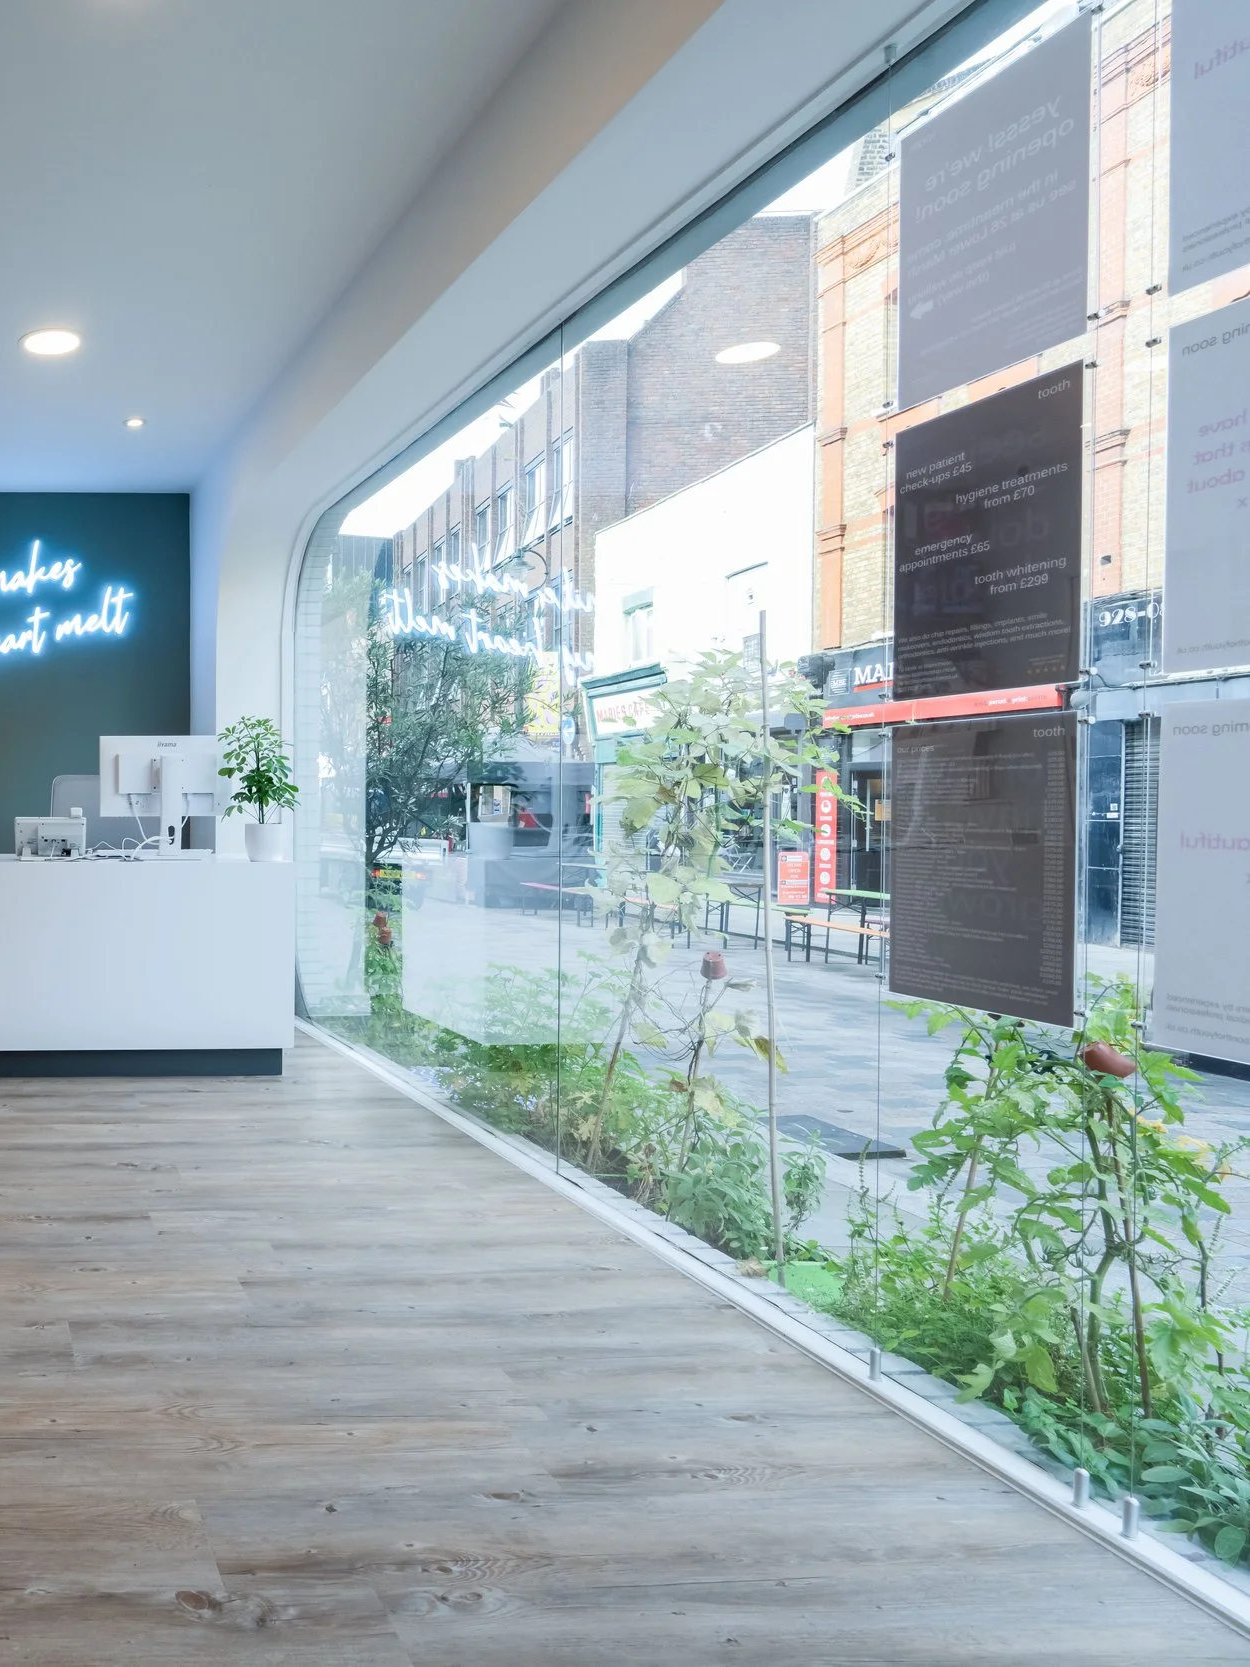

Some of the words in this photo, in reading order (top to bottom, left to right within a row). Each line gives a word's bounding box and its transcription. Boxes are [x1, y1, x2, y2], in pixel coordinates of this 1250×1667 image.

[1037, 379, 1070, 400] tooth
[899, 471, 950, 495] check-ups
[952, 461, 973, 478] £45
[906, 466, 926, 480] new
[929, 451, 965, 474] patient
[955, 482, 999, 505] hygiene
[1001, 462, 1068, 490] treatments
[984, 493, 1010, 509] from
[1013, 485, 1035, 501] £70
[899, 549, 968, 574] appointments
[970, 540, 991, 554] £65
[914, 532, 974, 557] emergency
[974, 569, 1004, 585] tooth
[1006, 556, 1067, 578] whitening
[989, 580, 1018, 595] from
[1019, 573, 1049, 590] £299
[55, 585, 134, 640] melt
[1033, 725, 1065, 738] tooth
